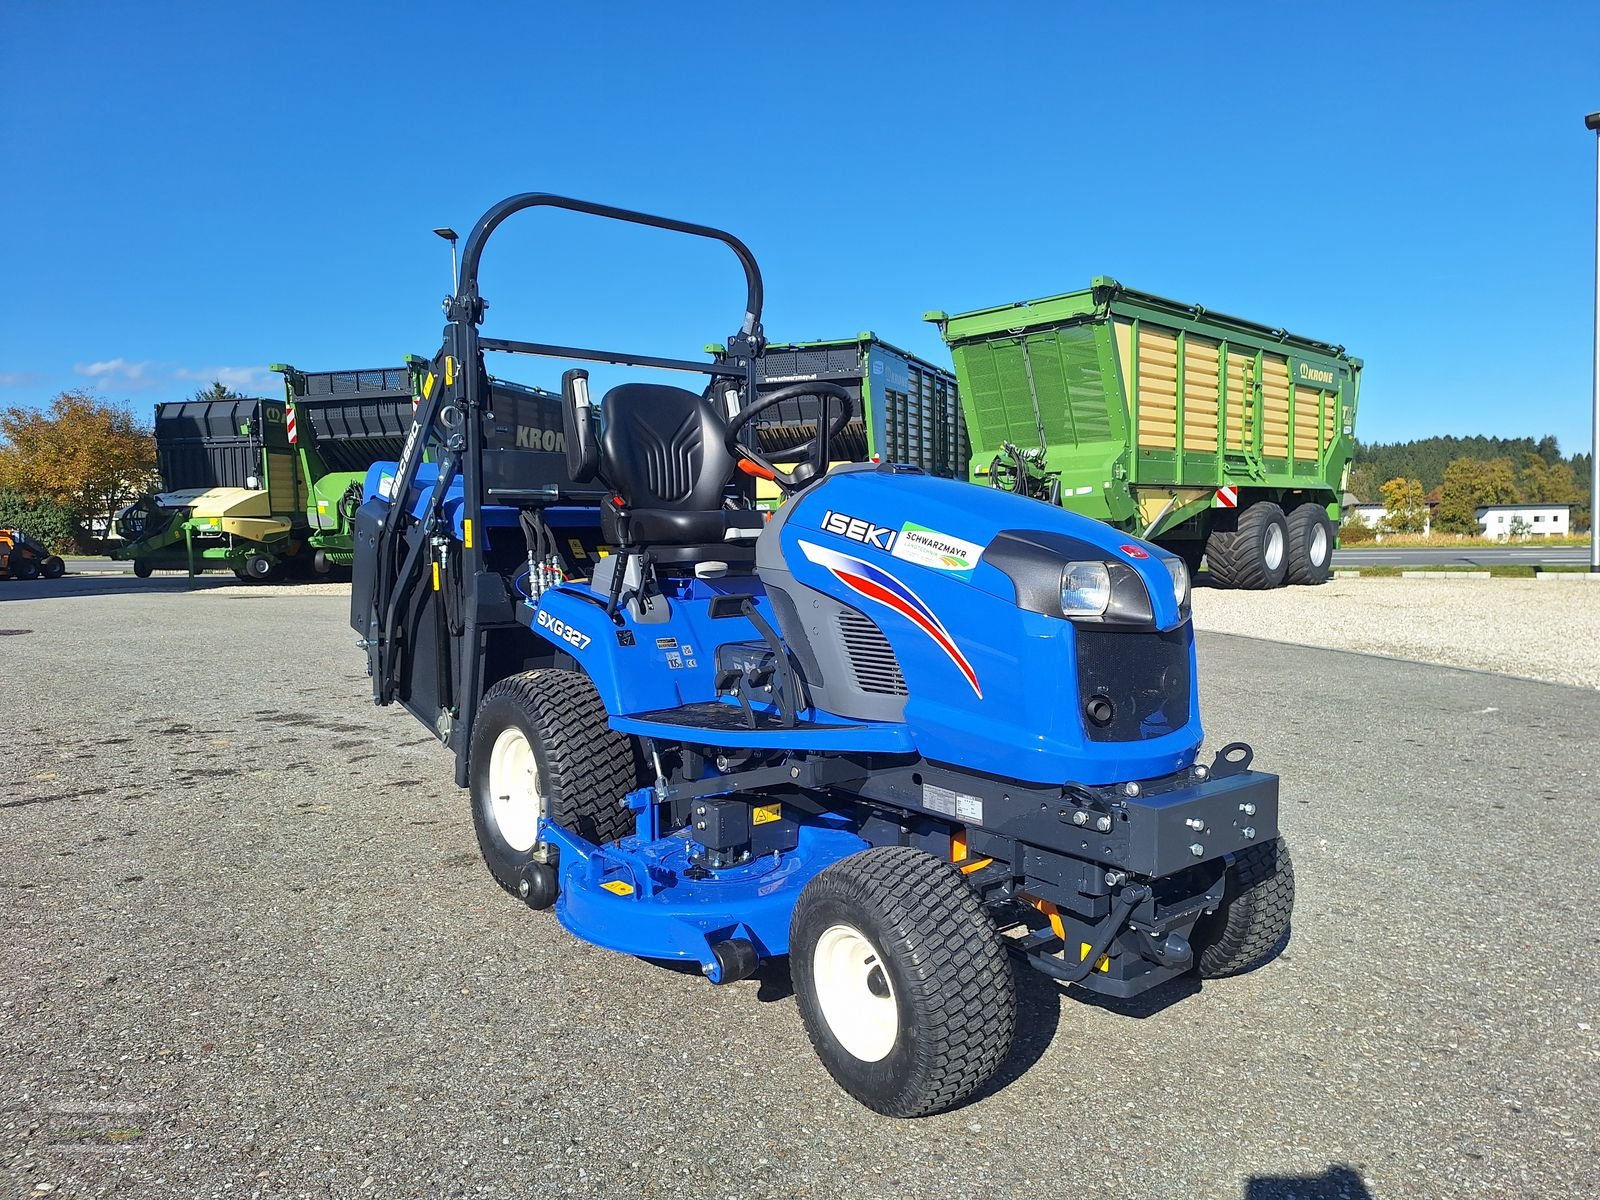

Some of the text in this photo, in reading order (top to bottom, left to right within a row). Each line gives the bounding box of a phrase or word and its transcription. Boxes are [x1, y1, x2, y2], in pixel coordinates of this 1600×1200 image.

[1308, 368, 1333, 383] KRONE
[516, 425, 567, 452] KRON
[820, 510, 898, 552] ISEKI
[906, 532, 967, 558] SCHWARZMAYR
